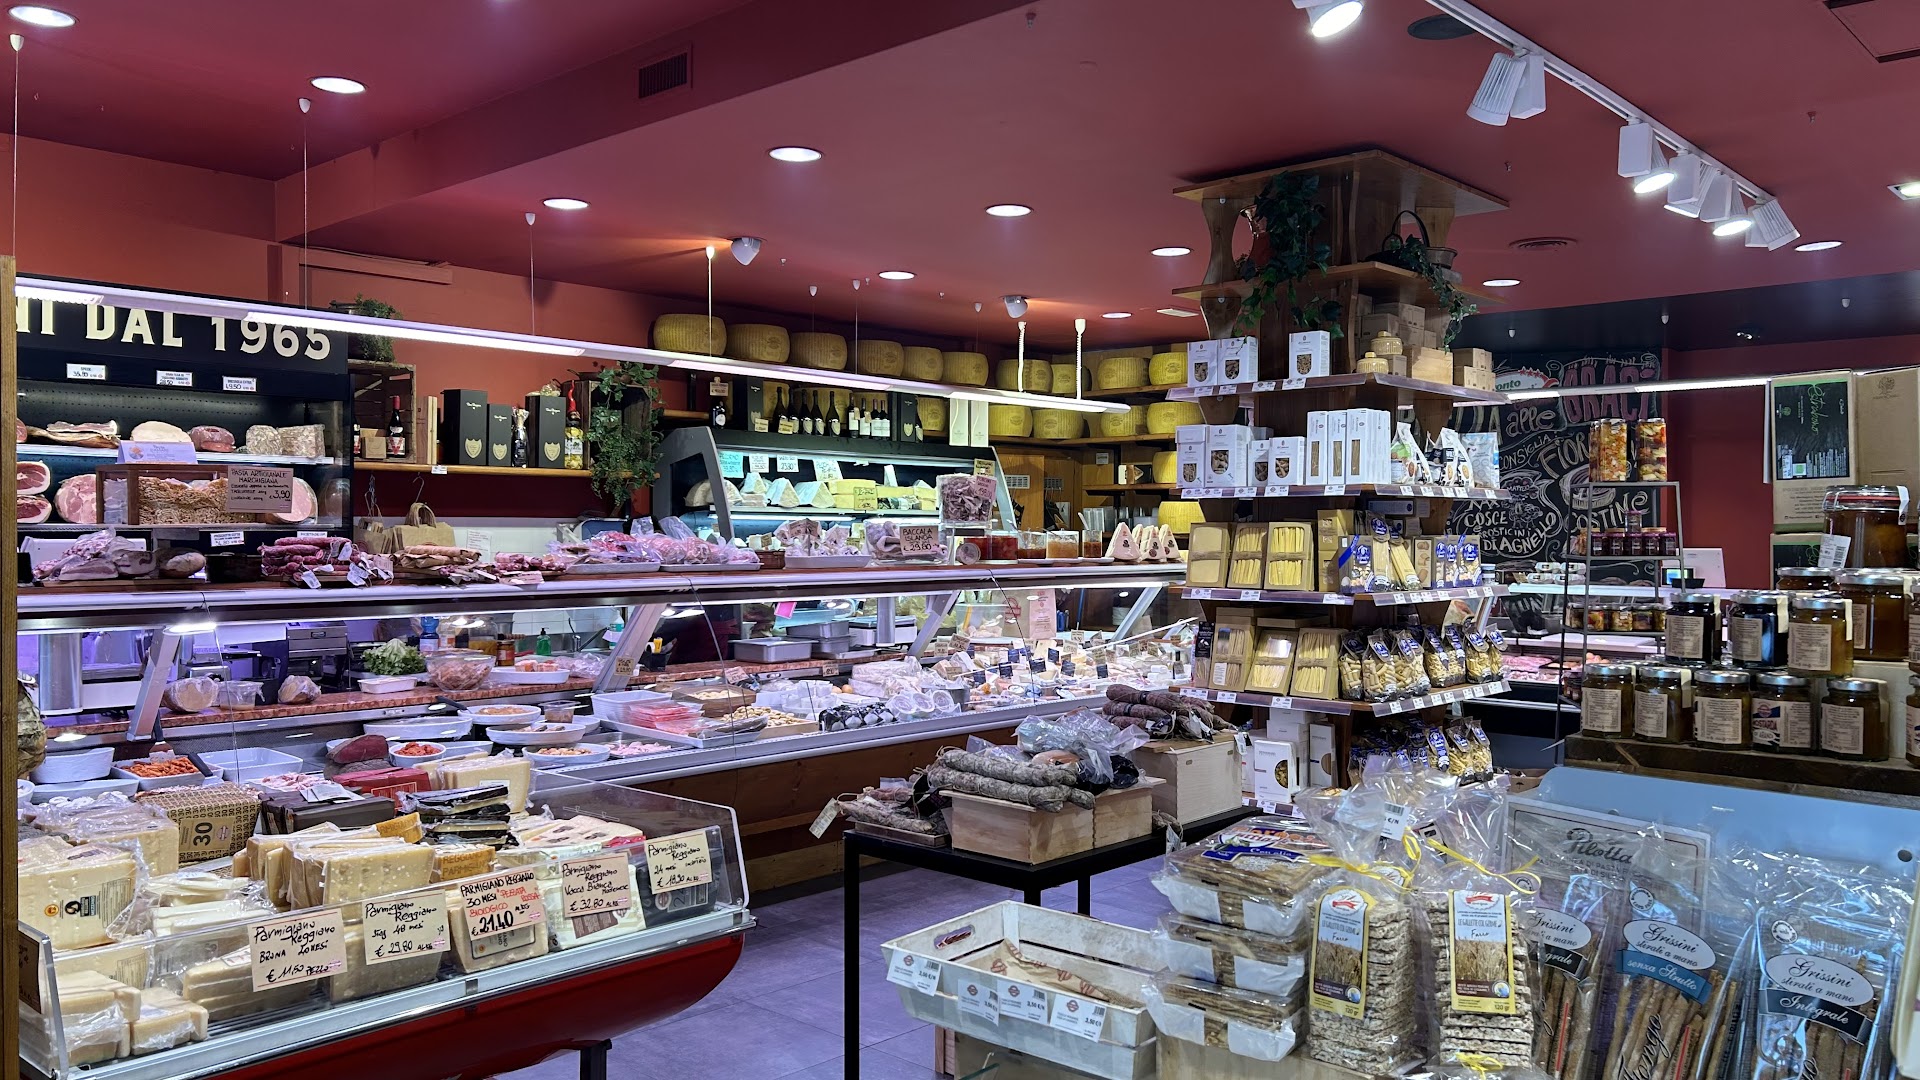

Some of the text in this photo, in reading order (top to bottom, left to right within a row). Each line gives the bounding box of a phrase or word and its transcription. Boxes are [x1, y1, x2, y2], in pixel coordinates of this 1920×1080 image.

[85, 302, 183, 347] DAL
[211, 315, 331, 361] 1965
[1495, 378, 1521, 391] onto
[1505, 406, 1557, 438] alle
[1464, 511, 1509, 528] COSCE
[1499, 512, 1558, 554] AGNELLO
[193, 821, 212, 847] 30
[648, 841, 687, 858] Parmigiano
[672, 847, 701, 861] Reggiano
[562, 863, 602, 878] Parmigiano
[585, 869, 618, 883] Reggiano
[653, 865, 664, 875] 24
[460, 872, 535, 897] PARMIGIANO REGGIANO
[564, 881, 613, 897] Vacca Bianca
[656, 878, 664, 887] €
[466, 896, 482, 908] 30
[481, 893, 498, 903] MESI
[569, 901, 577, 911] €
[365, 902, 415, 919] Parmigiano
[394, 906, 438, 923] Reggiano
[469, 902, 508, 917] BIOLOGICO
[392, 924, 406, 934] 48
[479, 910, 514, 933] 21,40
[1528, 912, 1577, 935] Grissini
[254, 920, 316, 944] Parmigiano
[291, 925, 336, 947] Reggiano
[1643, 925, 1700, 954] Grissini
[374, 946, 385, 958] €
[387, 939, 413, 955] 29,80
[1553, 936, 1578, 947] mano
[259, 950, 286, 963] BRUNA
[1545, 951, 1573, 967] grale
[1636, 940, 1663, 955] stirati
[1672, 954, 1699, 967] mano
[265, 969, 278, 983] €
[1627, 959, 1698, 991] senza Strutto
[1788, 957, 1852, 988] Grissini
[1781, 977, 1814, 993] stirati
[1825, 990, 1855, 1003] mano
[1780, 995, 1850, 1024] Integrale
